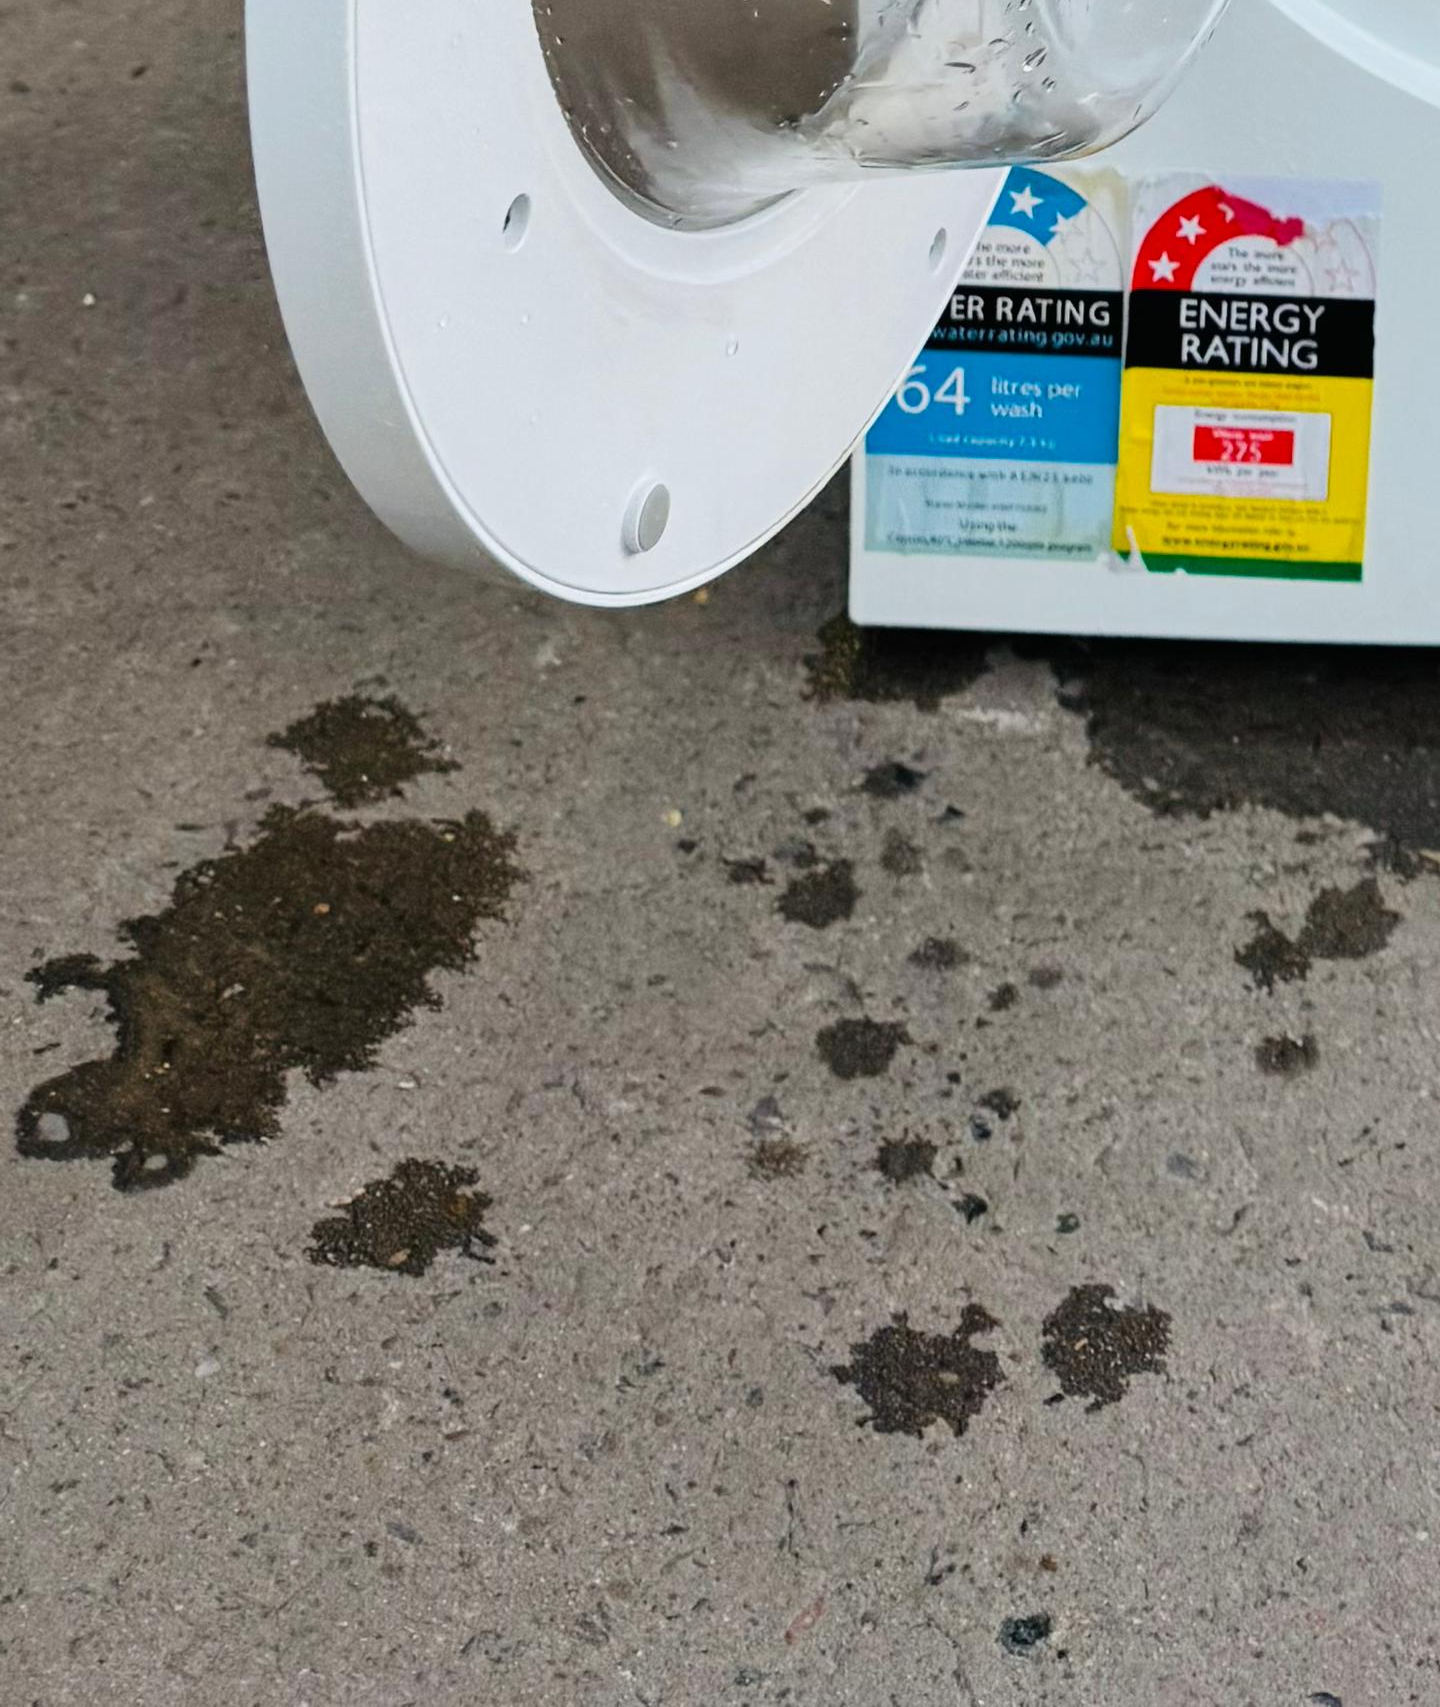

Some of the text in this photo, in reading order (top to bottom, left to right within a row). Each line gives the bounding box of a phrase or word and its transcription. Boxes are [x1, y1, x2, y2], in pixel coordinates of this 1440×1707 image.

[995, 243, 1031, 255] more
[1228, 247, 1249, 258] The
[985, 255, 1006, 268] the
[1011, 257, 1045, 269] more
[1243, 261, 1261, 273] the
[991, 271, 1044, 283] efficient
[1210, 276, 1247, 288] energy
[995, 295, 1111, 327] RATING
[1179, 298, 1326, 335] ENERGY
[1181, 333, 1319, 370] RATING
[895, 365, 971, 416] 64
[991, 376, 1081, 400] litres per
[990, 402, 1043, 419] wash
[1220, 440, 1262, 463] 275
